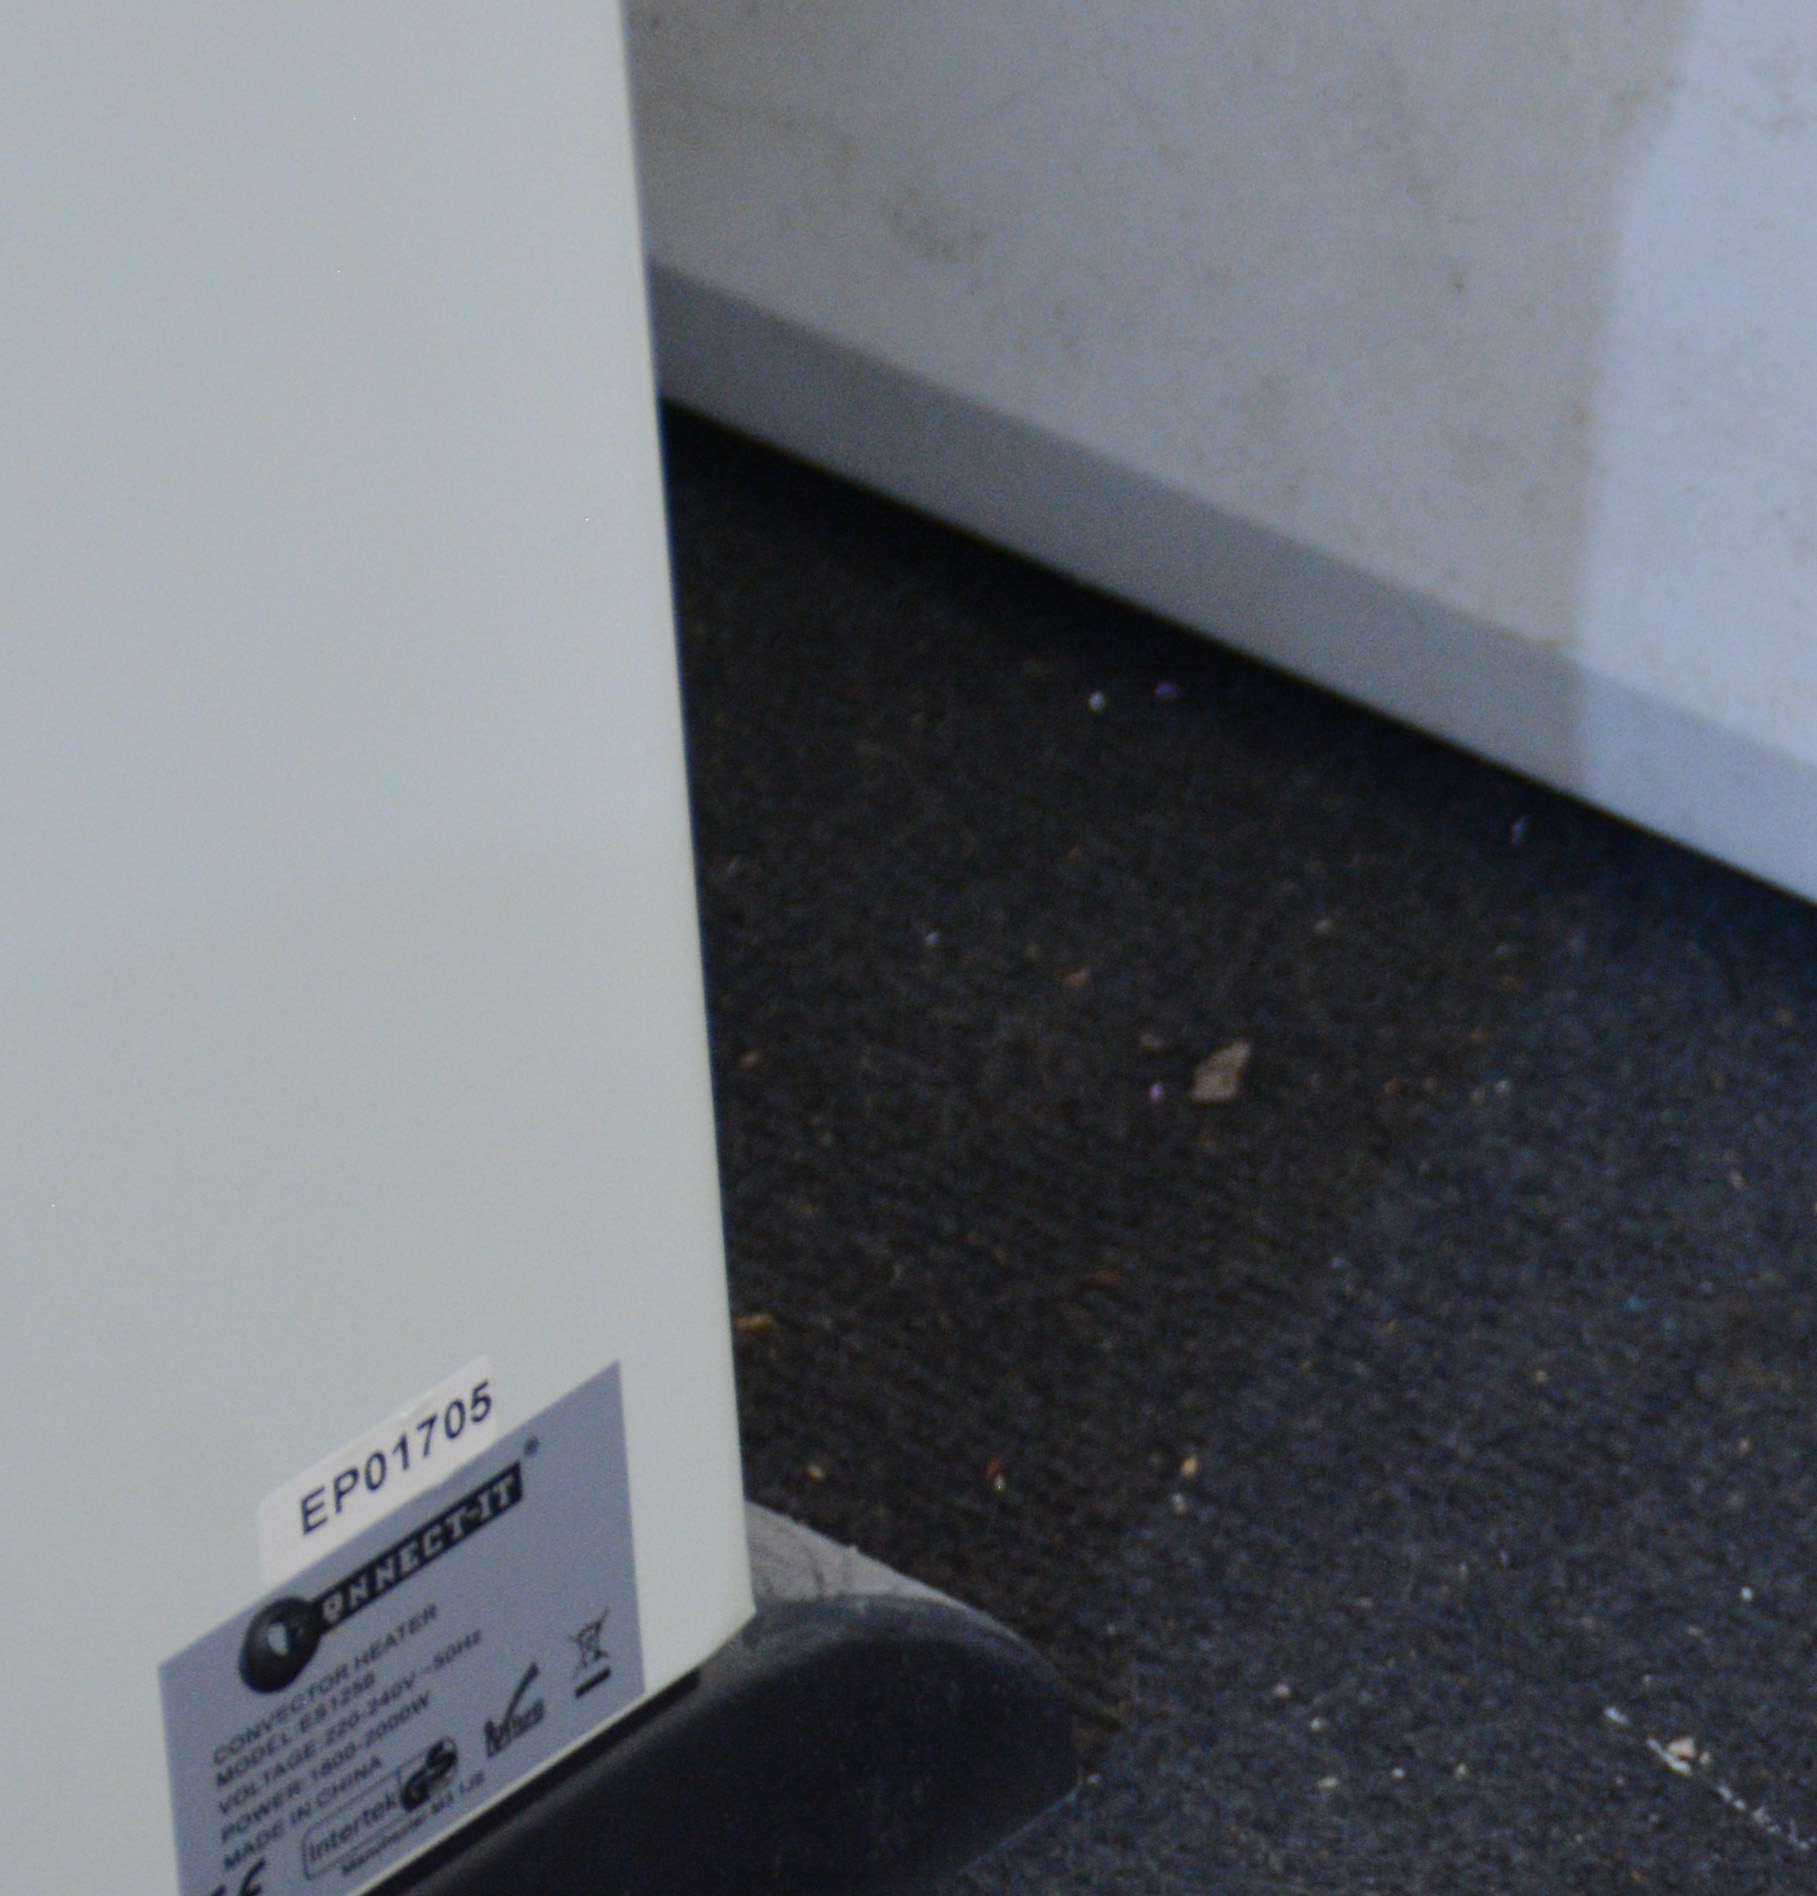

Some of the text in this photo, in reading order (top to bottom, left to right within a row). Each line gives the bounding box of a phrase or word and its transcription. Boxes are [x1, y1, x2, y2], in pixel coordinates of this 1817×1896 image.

[299, 1380, 493, 1537] EP01705
[213, 1603, 438, 1765] CONVECTOR HEATER
[216, 1732, 291, 1788] MODEL
[218, 1740, 314, 1815] VOLTAGE
[221, 1778, 300, 1843] POWER
[224, 1817, 284, 1871] MADE
[316, 1755, 382, 1808] CHINA
[308, 1790, 398, 1862] Intertek
